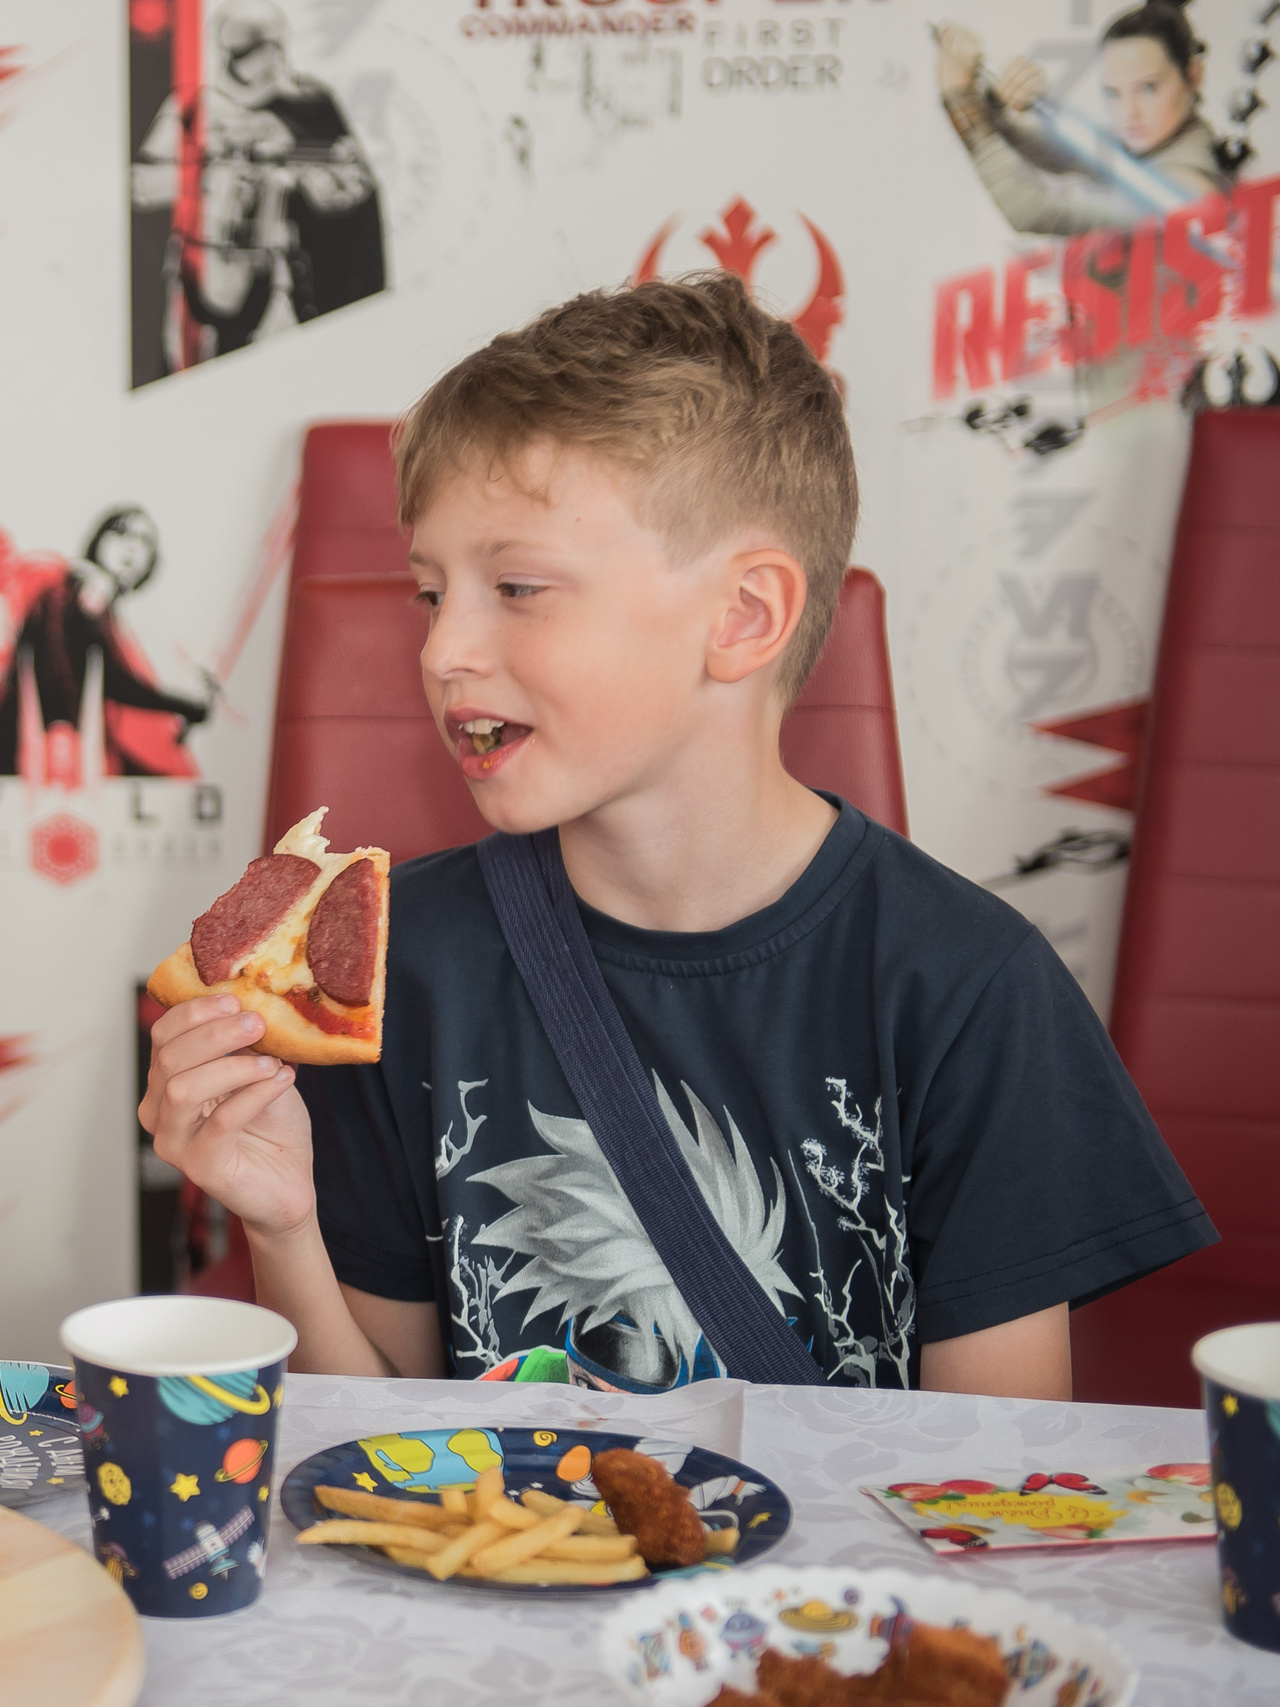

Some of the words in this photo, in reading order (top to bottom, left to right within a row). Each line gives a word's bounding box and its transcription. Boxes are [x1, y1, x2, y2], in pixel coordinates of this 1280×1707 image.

[460, 9, 696, 40] COMMANDER
[702, 17, 845, 49] FIRST
[701, 55, 844, 95] ORDER
